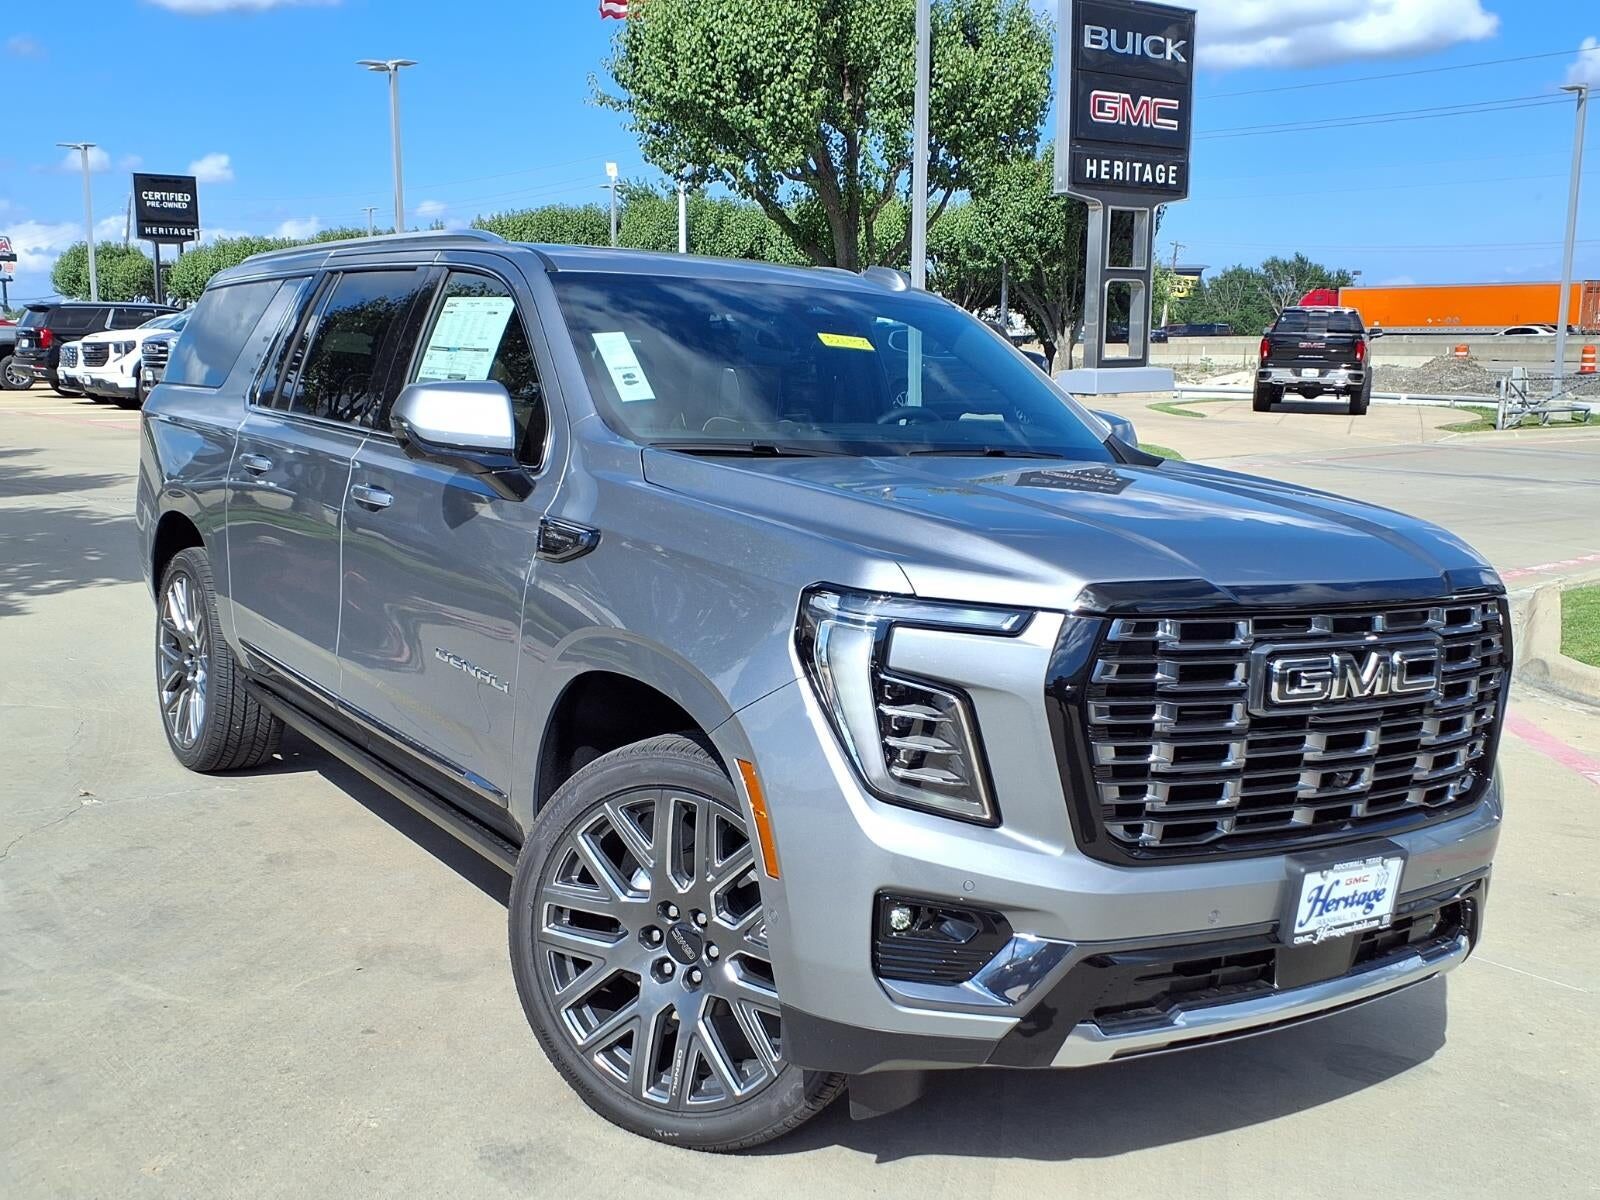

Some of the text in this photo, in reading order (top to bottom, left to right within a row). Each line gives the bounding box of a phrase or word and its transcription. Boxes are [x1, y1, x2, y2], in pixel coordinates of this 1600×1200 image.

[1083, 24, 1187, 64] BUICK
[1090, 89, 1179, 131] GMC
[1085, 158, 1178, 185] HERITAGE
[141, 190, 191, 202] CERTIFIED
[146, 200, 188, 209] PRE-OWNED
[144, 226, 193, 236] HERITAGE
[435, 647, 510, 694] DENALI
[1271, 648, 1438, 703] GMC
[1344, 874, 1370, 886] GMC
[1297, 879, 1386, 928] Heritage
[671, 927, 696, 960] GMC
